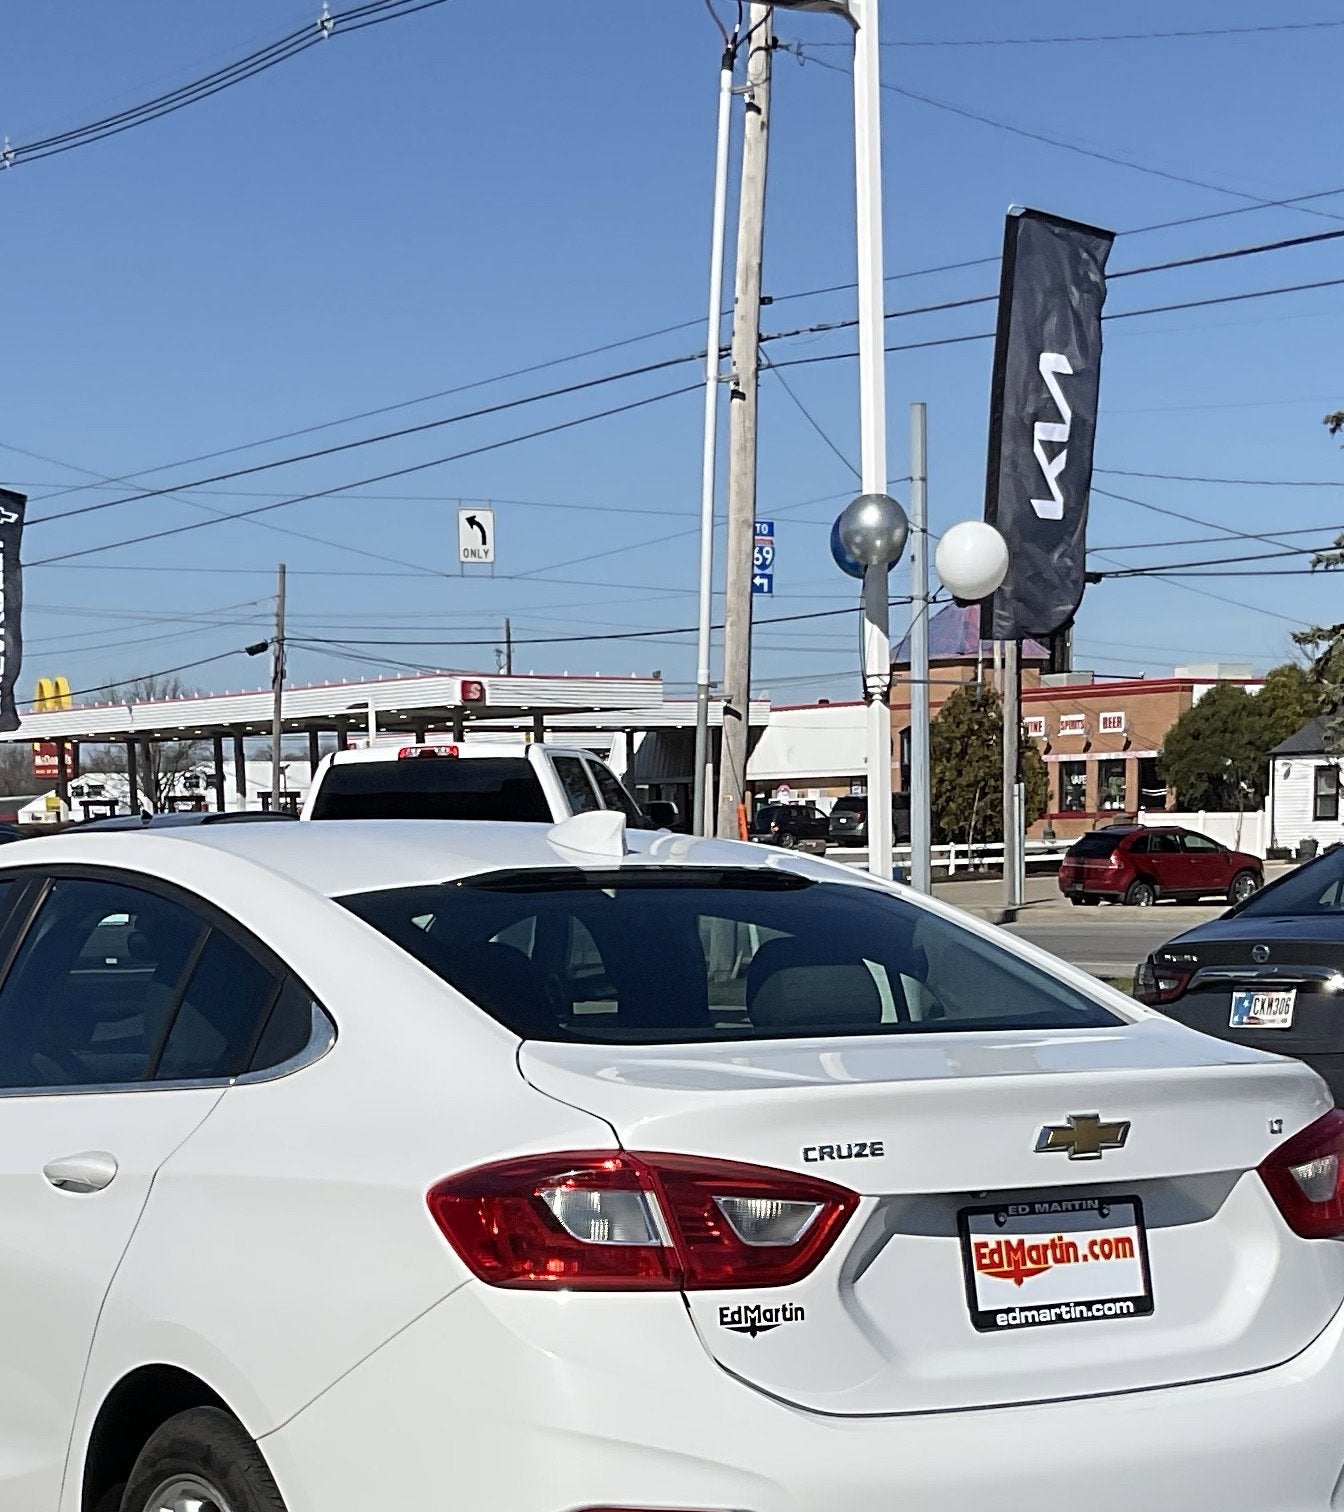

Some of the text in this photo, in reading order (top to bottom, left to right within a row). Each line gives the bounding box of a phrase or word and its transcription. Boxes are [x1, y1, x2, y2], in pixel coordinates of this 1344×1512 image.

[755, 523, 769, 534] TO
[463, 548, 490, 559] ONLY
[754, 546, 774, 565] 69
[1102, 716, 1123, 729] BEER
[802, 1141, 885, 1163] CRUZE
[1008, 1199, 1100, 1215] ED MARTIN
[974, 1236, 1135, 1271] EdMartin.com
[719, 1303, 806, 1326] EdMartin
[996, 1301, 1135, 1326] edmartin.com
